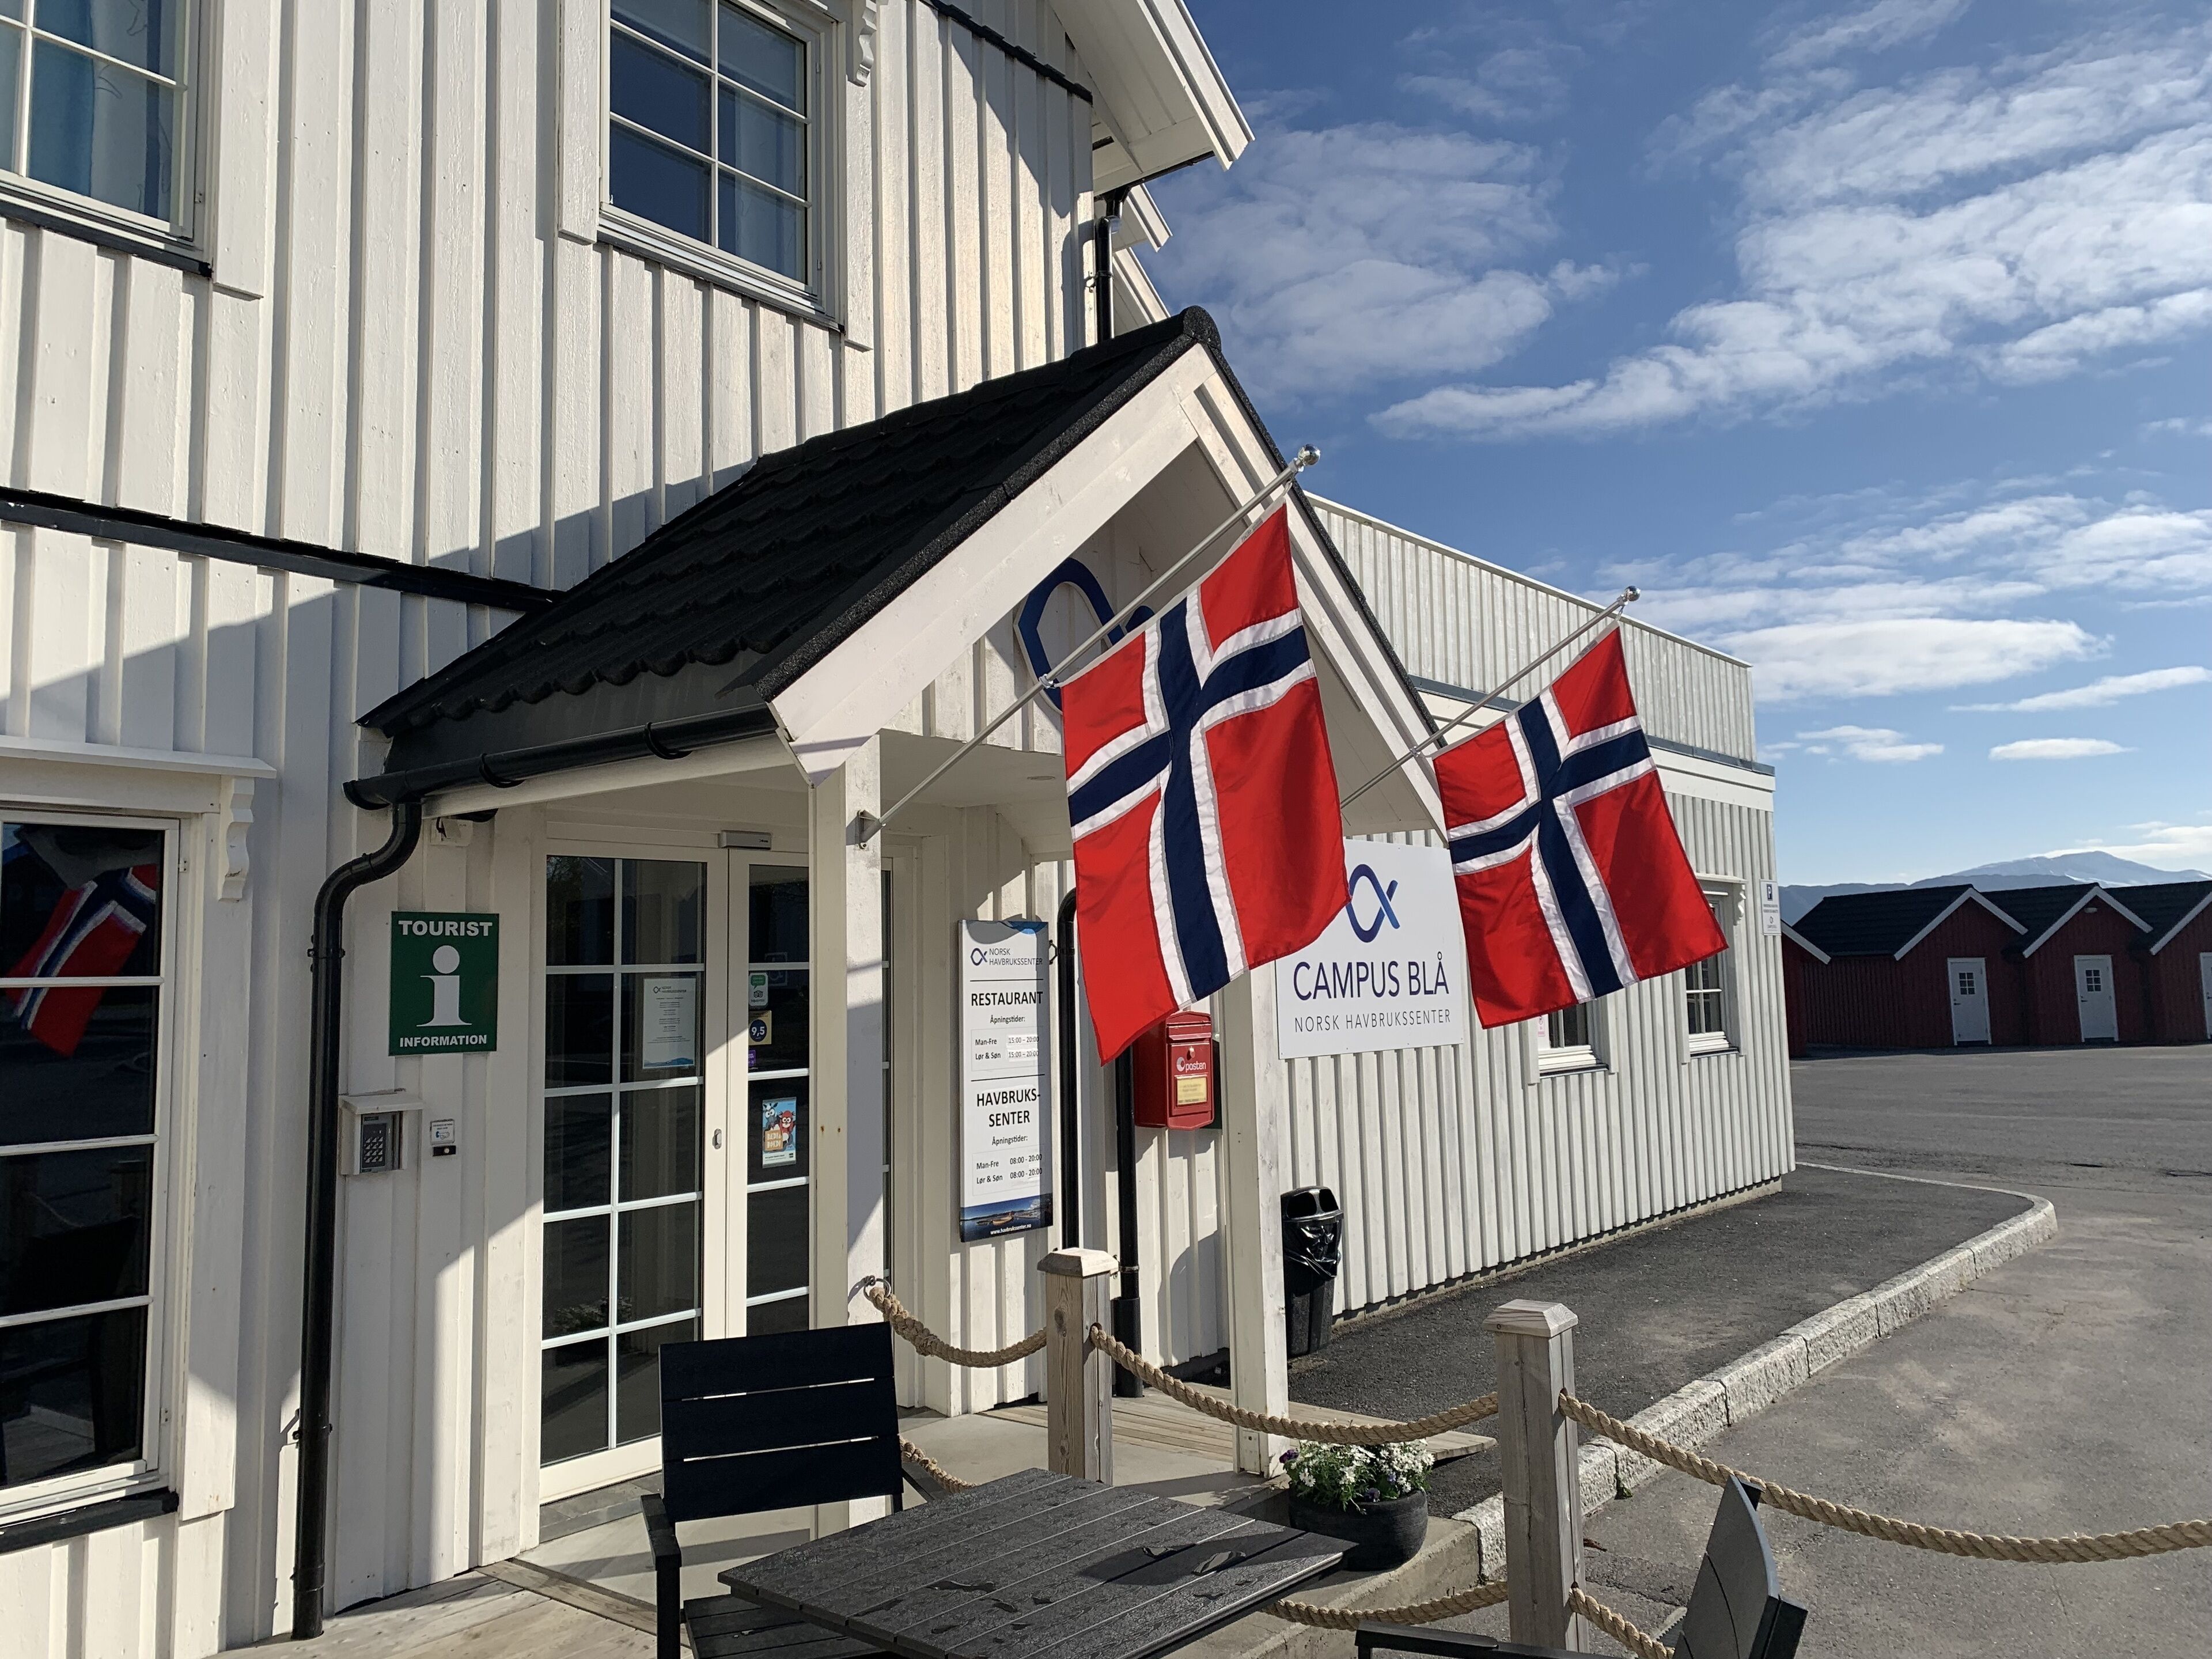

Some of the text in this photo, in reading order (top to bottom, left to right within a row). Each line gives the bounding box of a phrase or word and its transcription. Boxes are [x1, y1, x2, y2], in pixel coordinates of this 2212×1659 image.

[399, 921, 493, 936] TOURIST
[1294, 952, 1449, 1001] CAMPUS BLÅ
[971, 991, 1043, 1006] RESTAURANT
[990, 1014, 1025, 1025] Åpningstider:
[1295, 1009, 1450, 1033] NORSK HAVBRUKSSENTER
[752, 1027, 766, 1036] 9,5
[400, 1035, 487, 1047] INFORMATION
[1185, 1060, 1206, 1073] posten
[976, 1088, 1040, 1107] HAVBRUKS-
[988, 1110, 1030, 1127] SENTER
[992, 1135, 1028, 1146] Åpningstider:
[976, 1161, 999, 1169] Man-Fre
[1010, 1157, 1024, 1165] 08:00
[1029, 1154, 1042, 1162] 20:00
[1010, 1171, 1024, 1179] 08:00
[1029, 1168, 1042, 1176] 20:00
